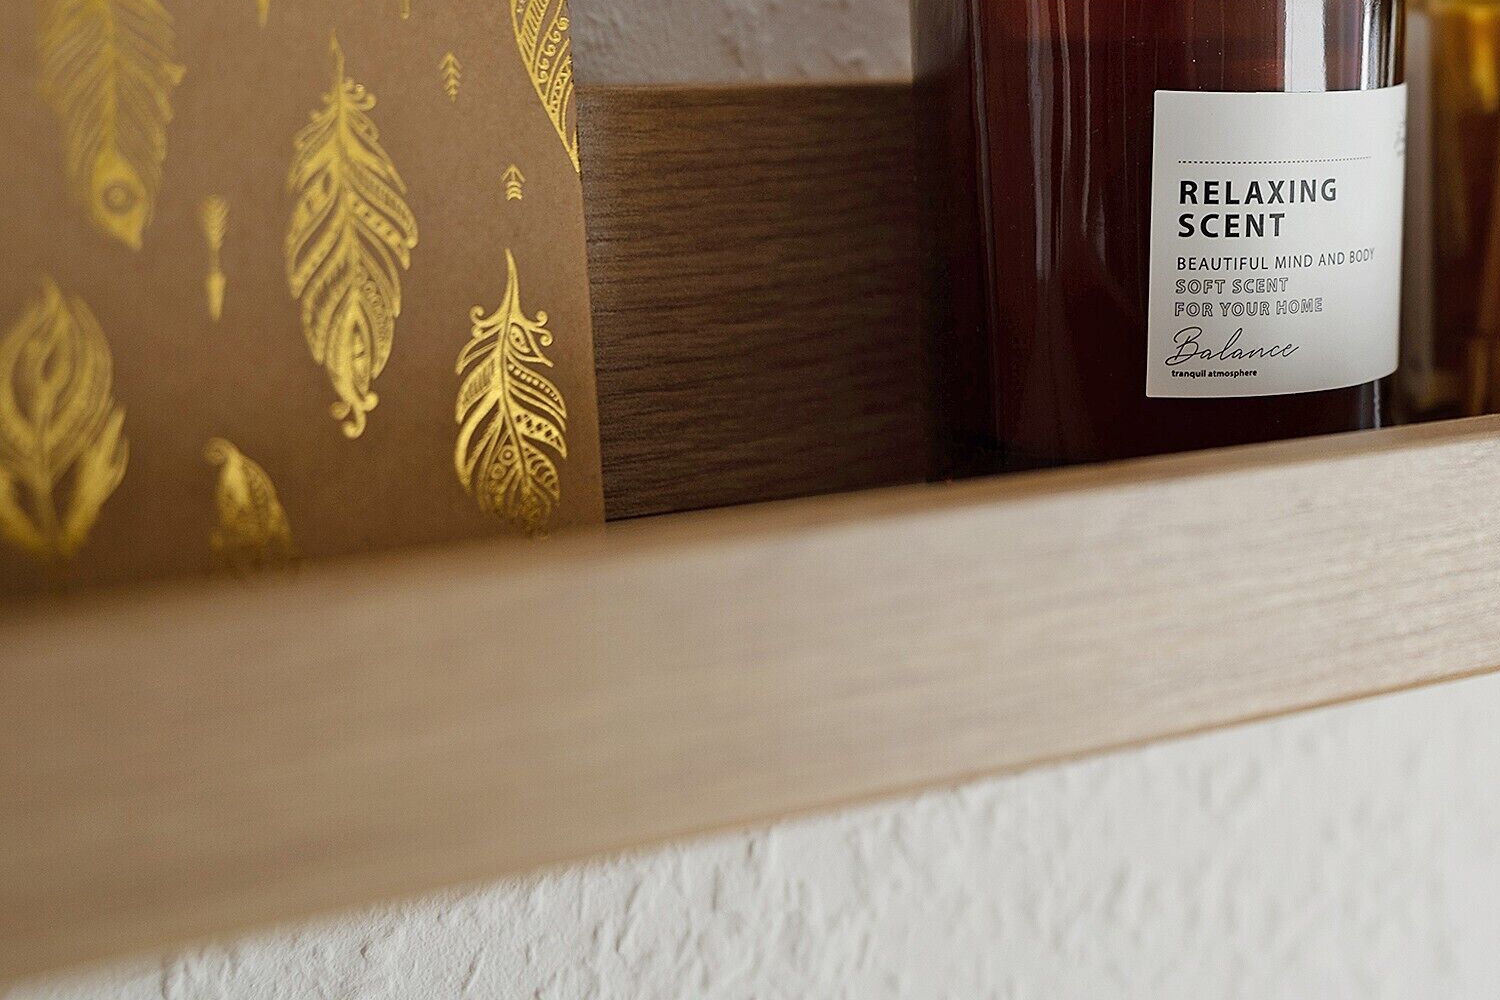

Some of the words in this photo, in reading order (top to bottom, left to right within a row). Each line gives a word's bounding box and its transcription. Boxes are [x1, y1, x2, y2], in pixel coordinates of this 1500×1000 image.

[1179, 178, 1337, 205] RELAXING
[1178, 213, 1286, 238] SCENT
[1177, 256, 1269, 271] BEAUTIFUL
[1275, 254, 1312, 269] MIND
[1318, 251, 1345, 267] AND
[1349, 247, 1375, 264] BODY
[1175, 279, 1226, 294] SOFT
[1232, 277, 1289, 294] SCENT
[1174, 302, 1213, 317] FOR
[1220, 301, 1270, 317] YOUR
[1276, 297, 1323, 315] HOME
[1165, 326, 1300, 366] Balance
[1171, 368, 1206, 379] tranquil
[1208, 368, 1258, 379] atmosphere
